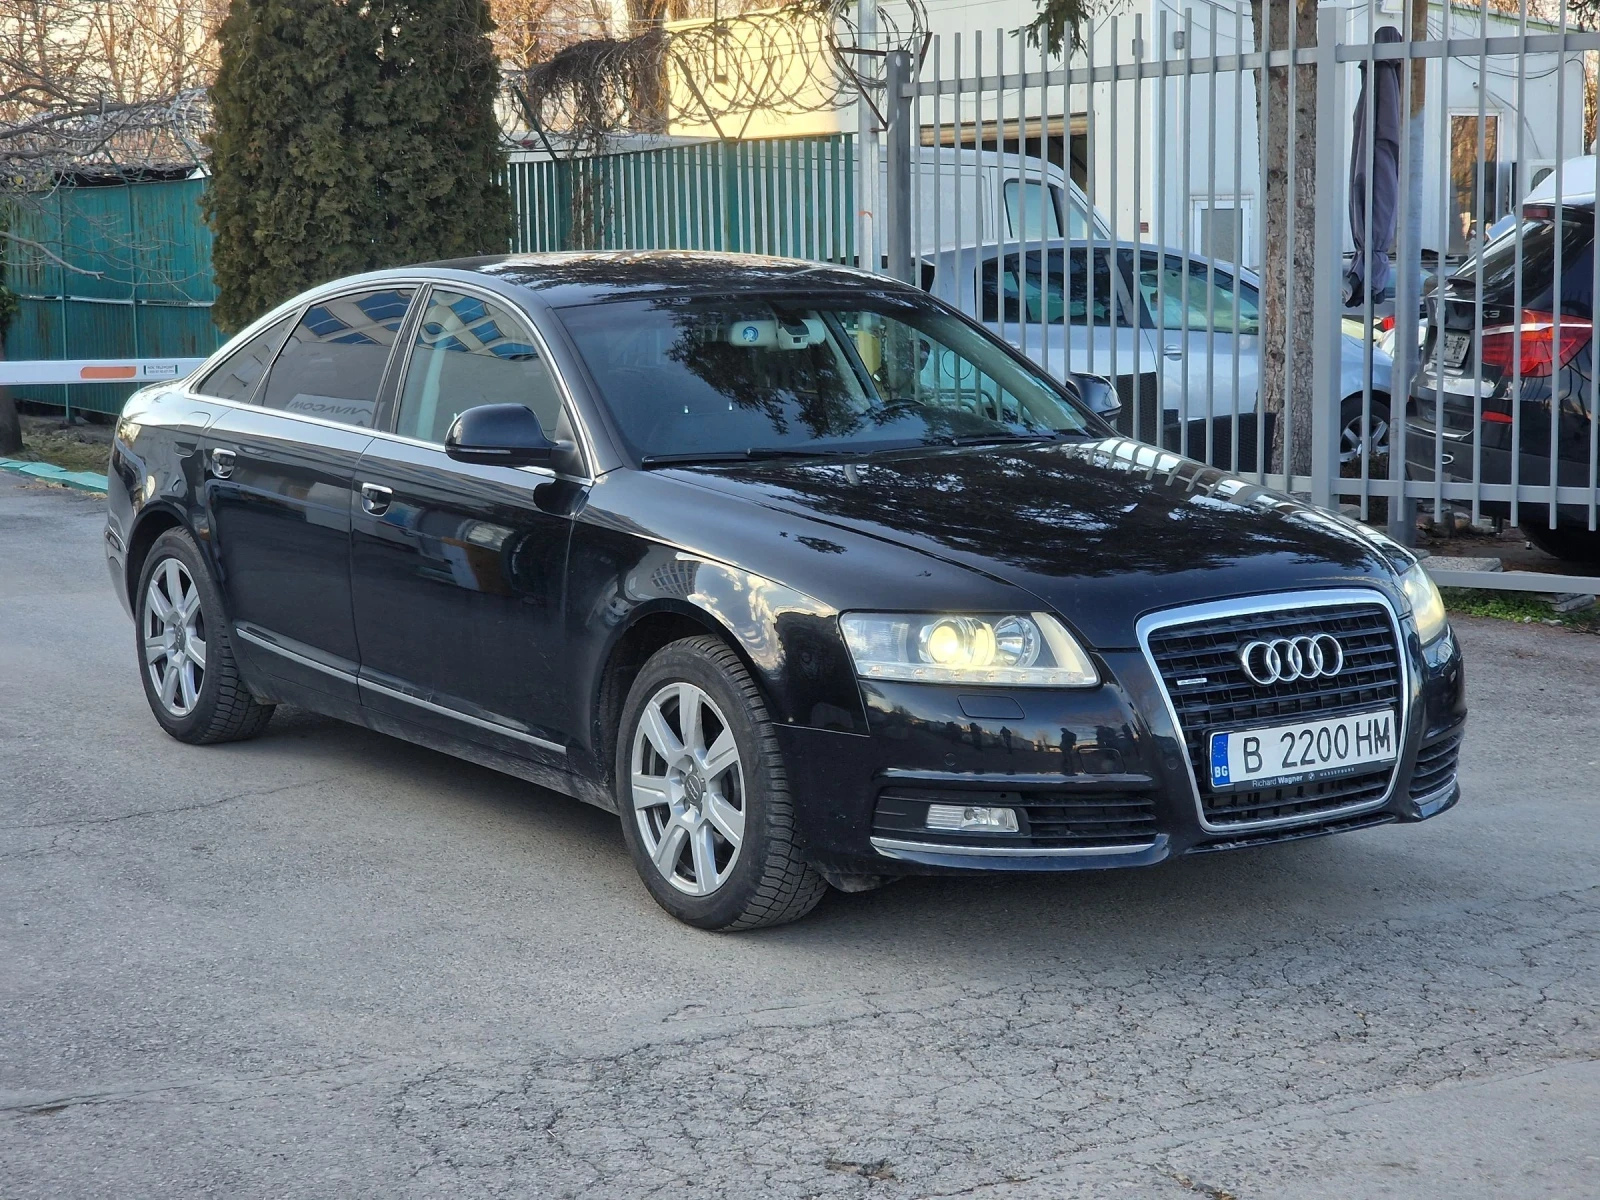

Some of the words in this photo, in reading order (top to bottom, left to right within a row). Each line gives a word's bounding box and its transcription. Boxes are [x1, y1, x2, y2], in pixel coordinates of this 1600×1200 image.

[1243, 736, 1263, 774] B
[1280, 724, 1349, 769] 2200
[1355, 716, 1391, 757] HM
[1214, 765, 1229, 778] BG
[1252, 778, 1277, 788] Richard
[1277, 775, 1303, 785] Wagner
